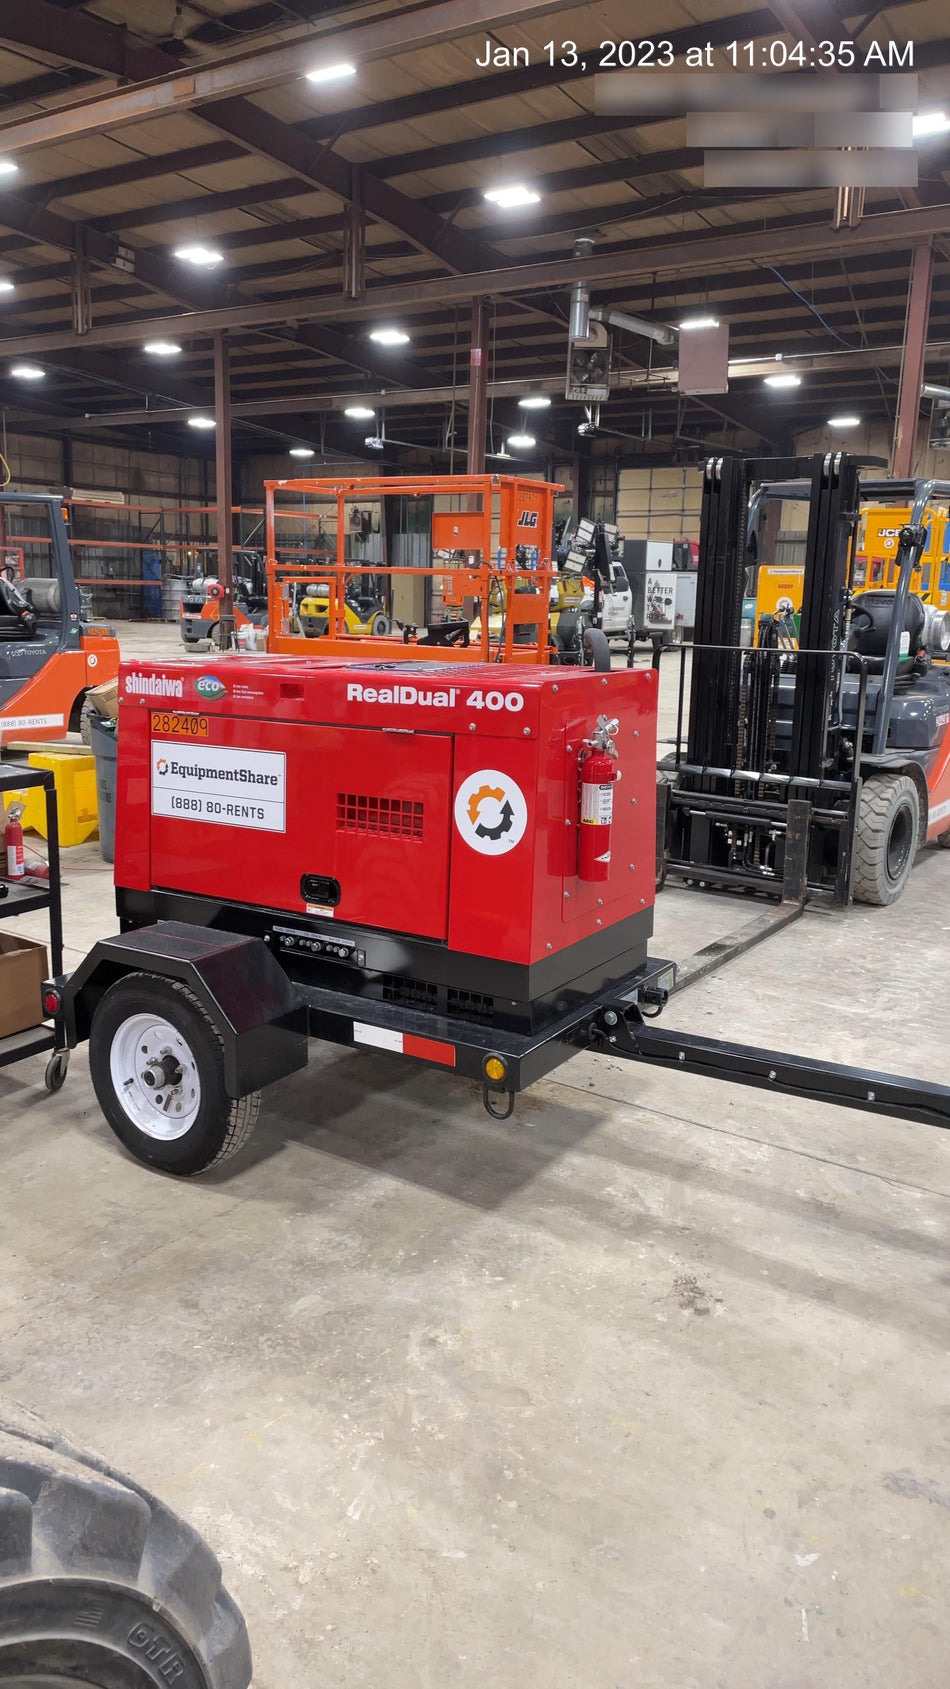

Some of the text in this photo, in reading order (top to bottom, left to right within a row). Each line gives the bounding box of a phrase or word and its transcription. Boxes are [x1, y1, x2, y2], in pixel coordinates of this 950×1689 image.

[517, 510, 539, 528] JLG
[647, 577, 653, 585] A
[647, 586, 674, 594] BETTER
[125, 671, 184, 698] shindaiwa
[197, 679, 220, 692] eco
[346, 683, 525, 713] RealDual 400
[1, 720, 17, 728] (888)
[152, 714, 208, 737] 282409
[170, 761, 279, 789] EquipmentShare
[170, 795, 265, 820] (888) 80-RENTS
[127, 1620, 184, 1686] OTR
